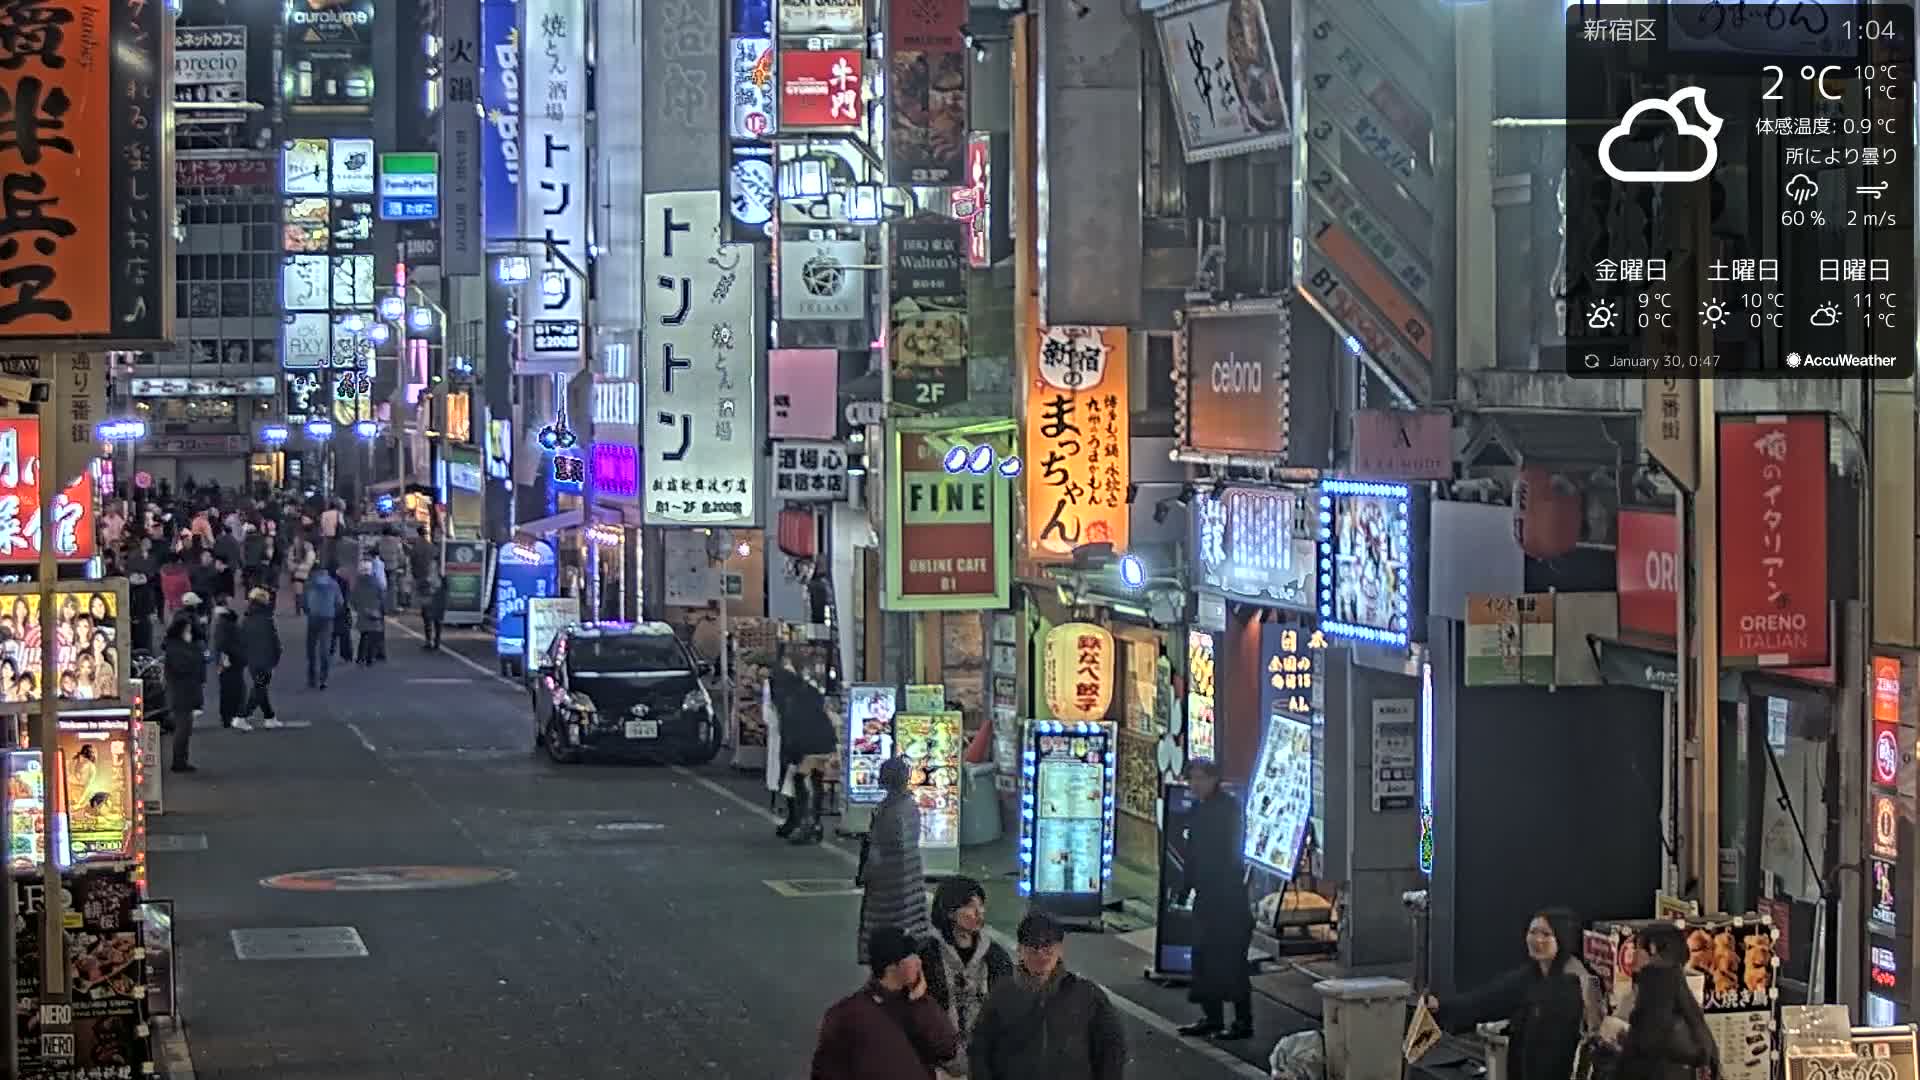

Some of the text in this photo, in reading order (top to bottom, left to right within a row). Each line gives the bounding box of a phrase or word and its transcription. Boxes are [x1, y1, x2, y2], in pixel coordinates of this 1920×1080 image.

[1314, 20, 1331, 41] 5
[829, 57, 858, 119] 牛門
[1314, 72, 1331, 91] 4
[1313, 120, 1333, 141] 3
[1312, 171, 1332, 194] 2
[541, 134, 571, 311] トントン
[1312, 267, 1338, 298] B1
[656, 207, 692, 461] トントン
[1043, 338, 1101, 372] 新宿
[1063, 370, 1083, 386] の
[1211, 350, 1262, 394] celona
[916, 383, 945, 403] 2F
[1040, 394, 1085, 542] まっちゃん
[777, 472, 843, 492] 新宿本店
[909, 483, 986, 512] FINE
[1753, 429, 1788, 602] 俺のイタリアン
[908, 558, 987, 573] ONLINE CAFE
[1739, 613, 1807, 632] ORENO
[1739, 633, 1808, 650] ITALIAN
[1076, 635, 1102, 712] 鉄なべ餃子
[41, 1003, 72, 1025] NERO
